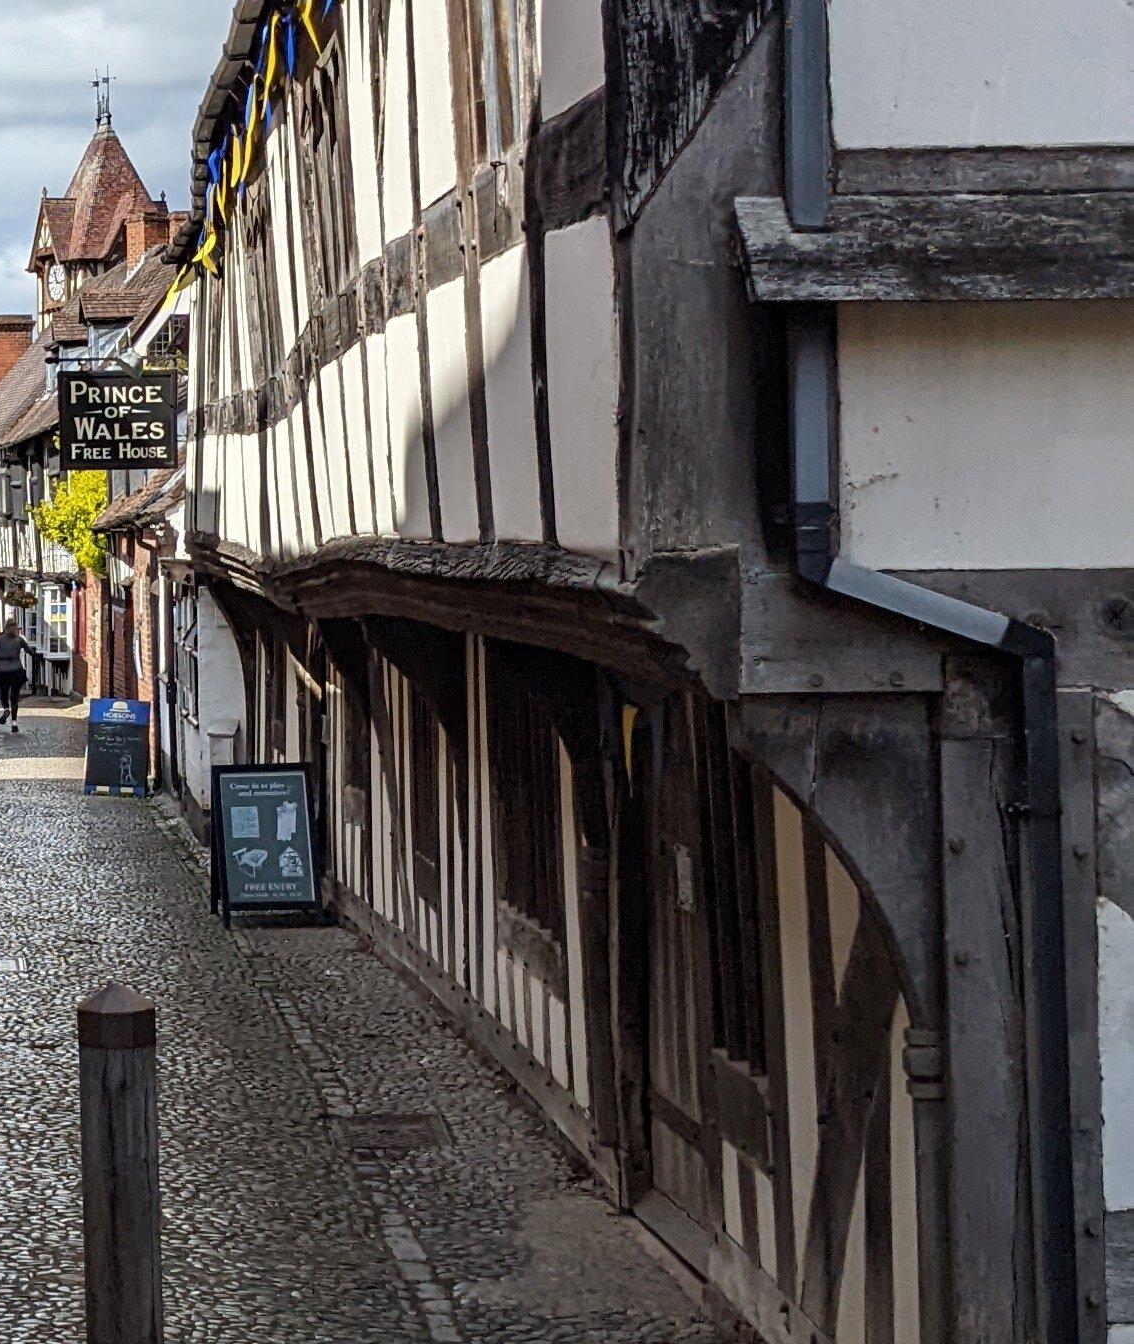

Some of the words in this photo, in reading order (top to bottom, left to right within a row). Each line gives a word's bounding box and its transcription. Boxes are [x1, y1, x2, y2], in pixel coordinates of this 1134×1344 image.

[70, 380, 163, 404] PRINCE
[104, 406, 132, 419] OF
[74, 417, 165, 440] WALES
[71, 443, 112, 459] FREE
[118, 442, 168, 459] HOUSE
[103, 712, 136, 720] HOBSONS
[245, 883, 265, 891] FREE
[268, 882, 297, 891] ENTRY
